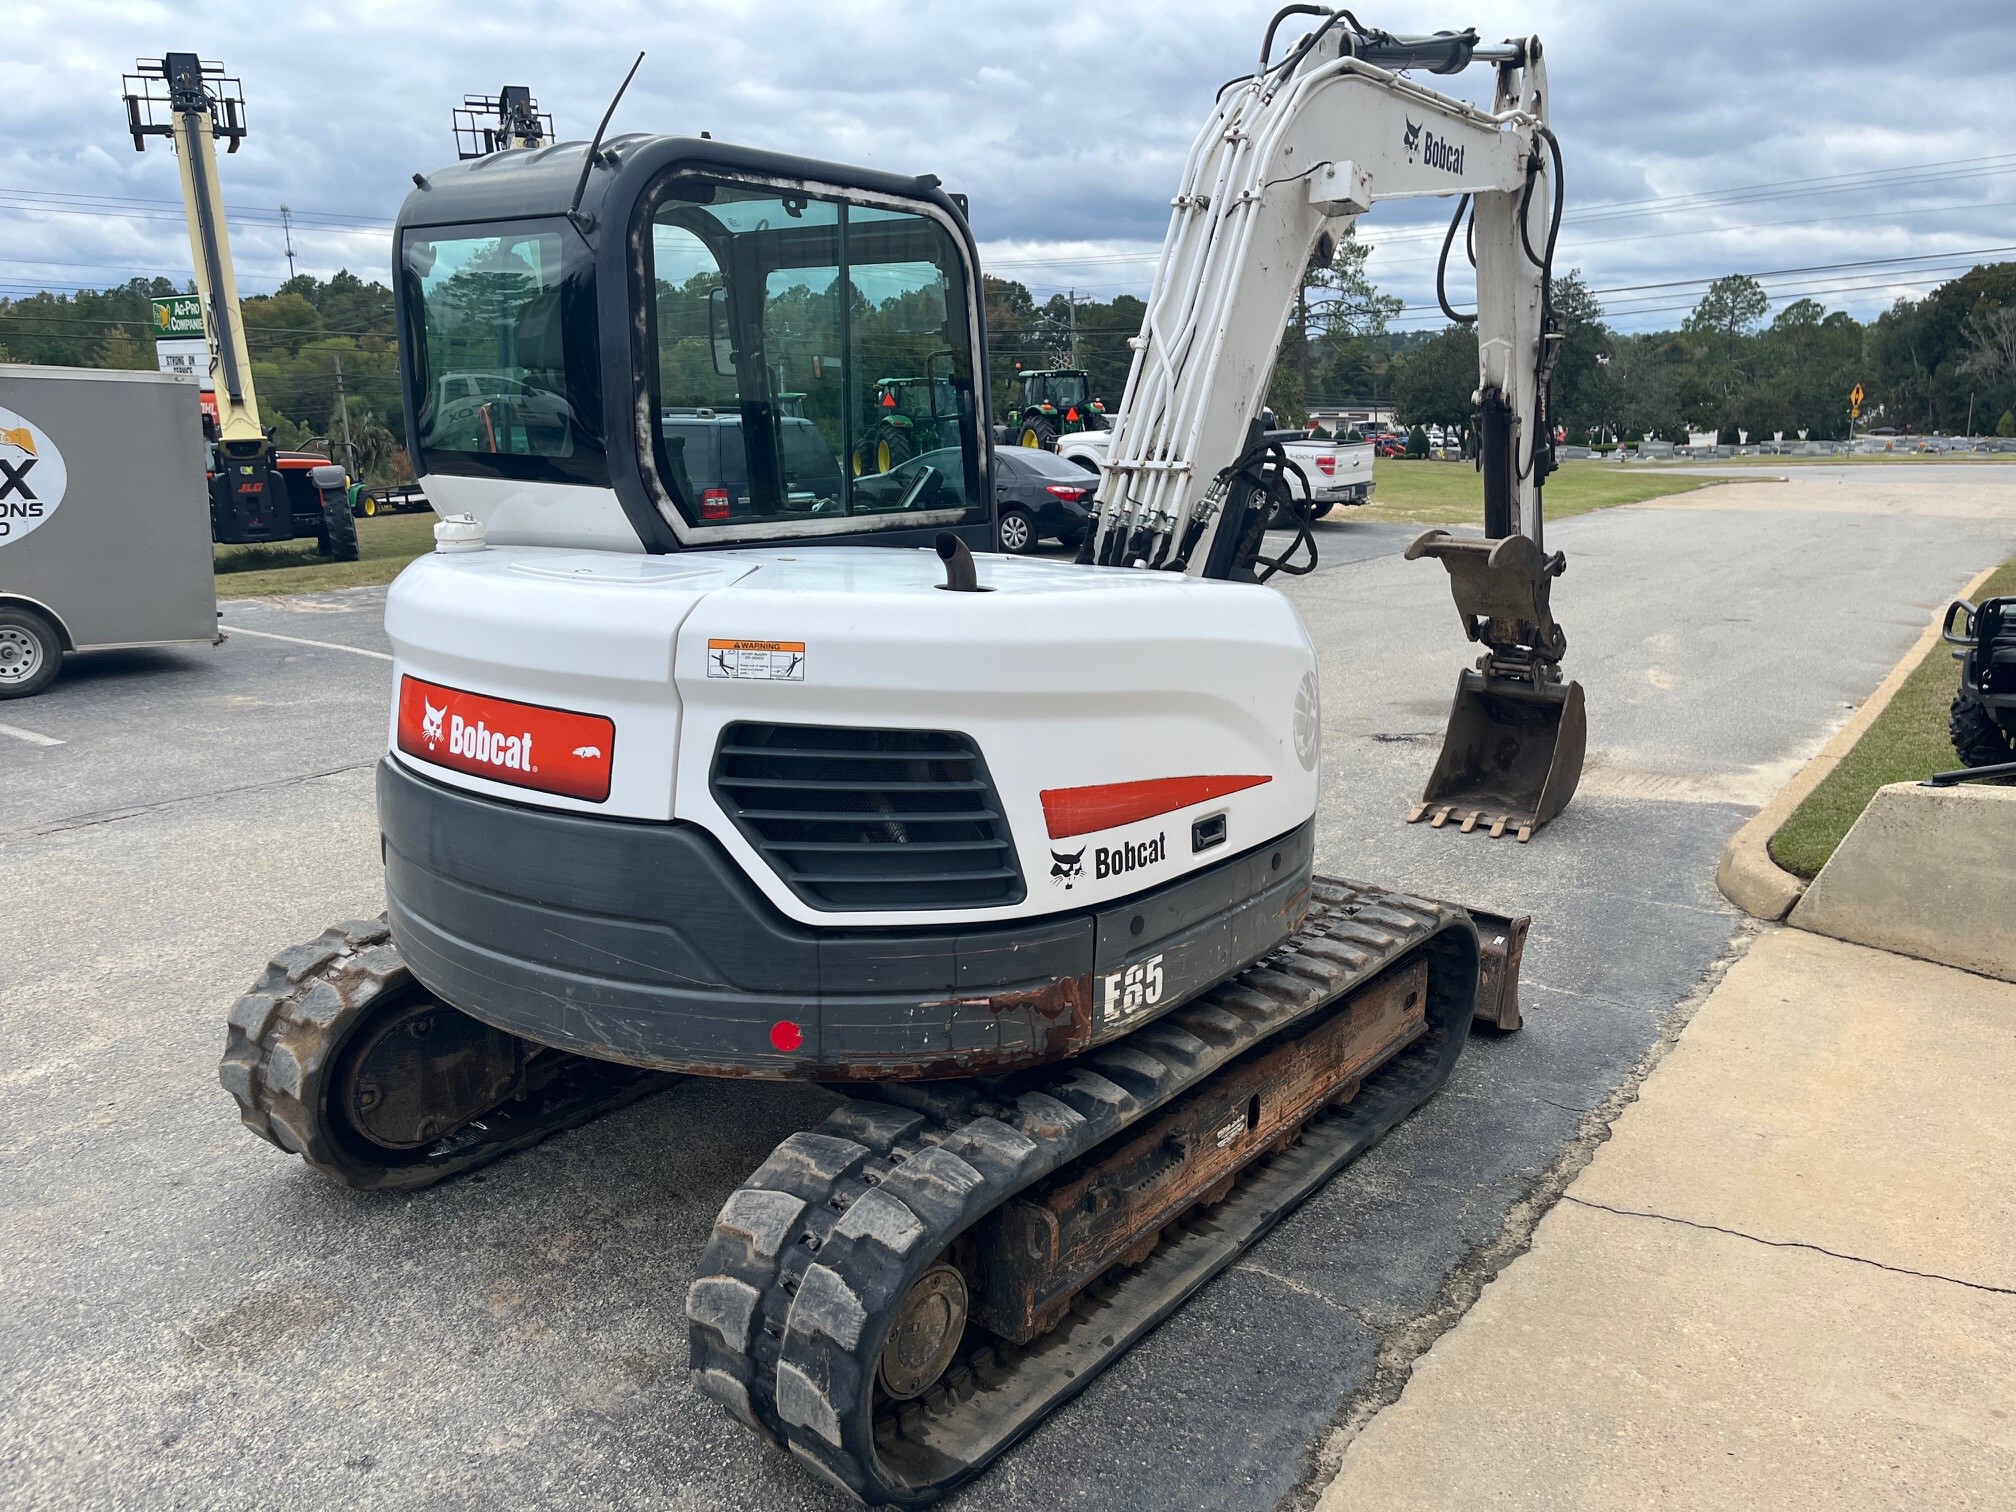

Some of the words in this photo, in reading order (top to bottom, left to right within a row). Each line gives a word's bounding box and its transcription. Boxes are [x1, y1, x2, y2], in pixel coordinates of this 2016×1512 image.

[1424, 131, 1464, 176] Bobcat
[171, 317, 204, 331] COMPANIE
[166, 356, 184, 366] STRONG
[188, 356, 195, 366] ON
[200, 402, 217, 416] TIHL
[238, 483, 263, 493] JLG
[450, 714, 533, 772] Bobcat
[1095, 831, 1166, 880] Bobcat
[1104, 953, 1164, 1022] E85
